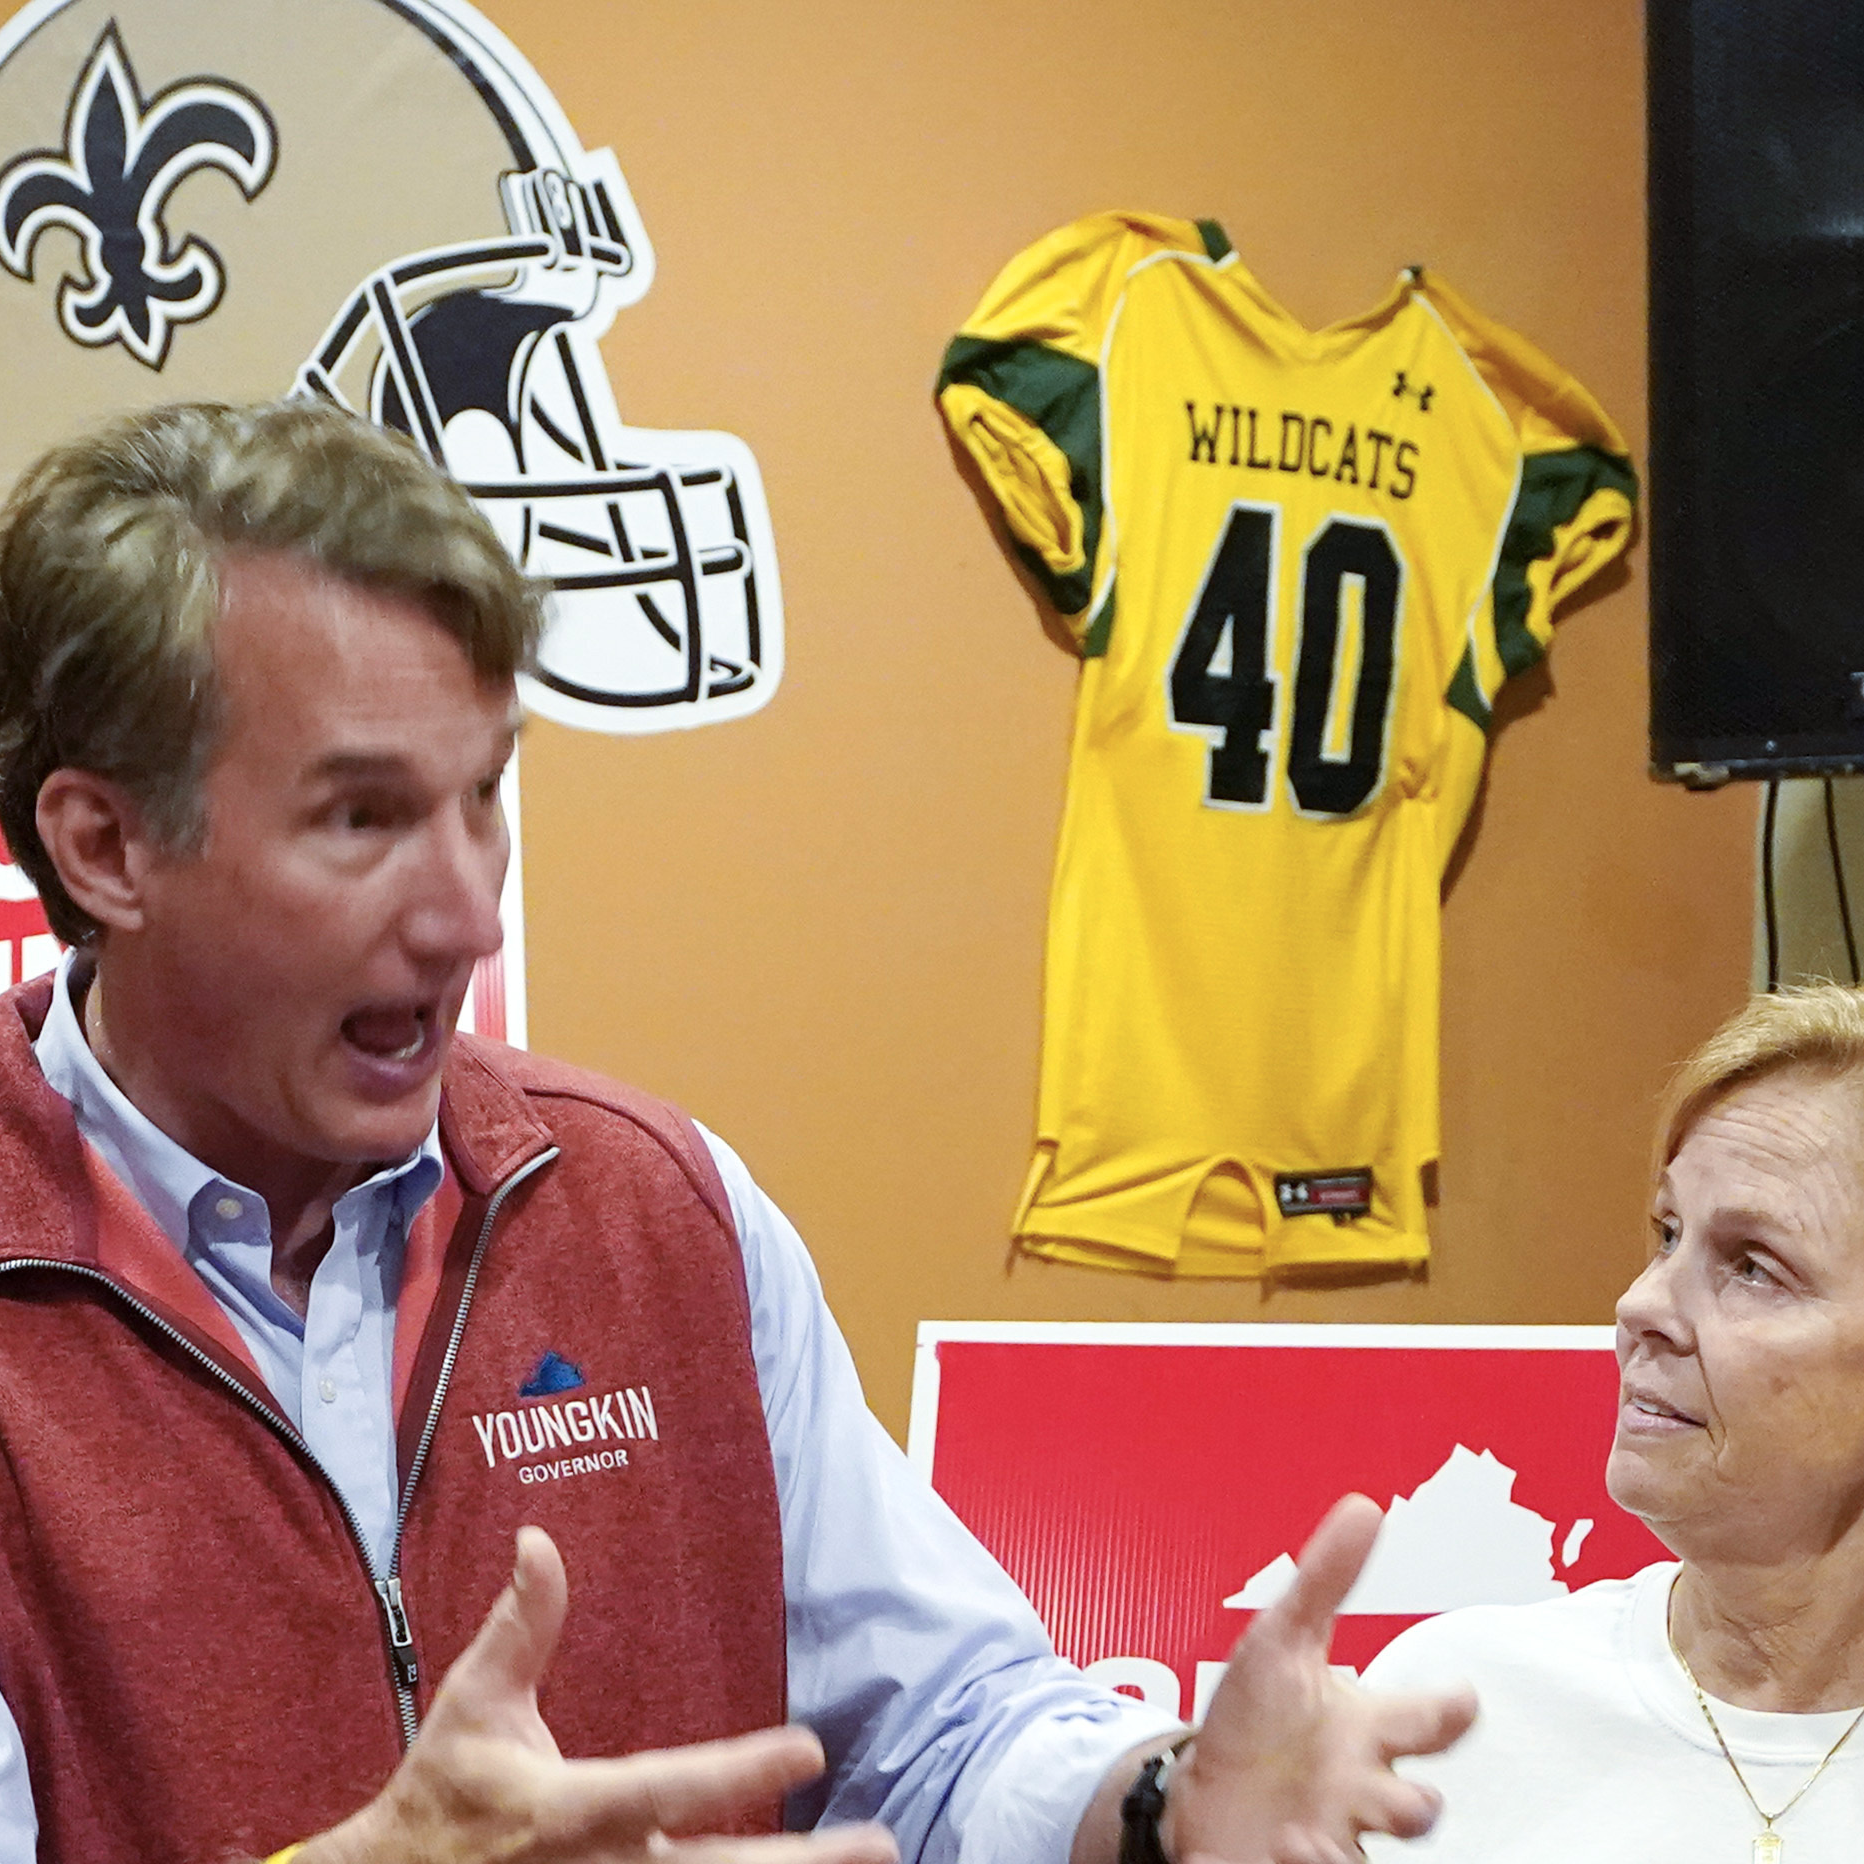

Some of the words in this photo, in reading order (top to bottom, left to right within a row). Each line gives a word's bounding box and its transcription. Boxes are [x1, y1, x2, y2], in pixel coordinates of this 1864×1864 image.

[1184, 401, 1421, 501] WILDCATS
[1164, 499, 1407, 820] 40
[472, 1386, 659, 1468] YOUNGKIN
[519, 1449, 629, 1484] GOVERNOR
